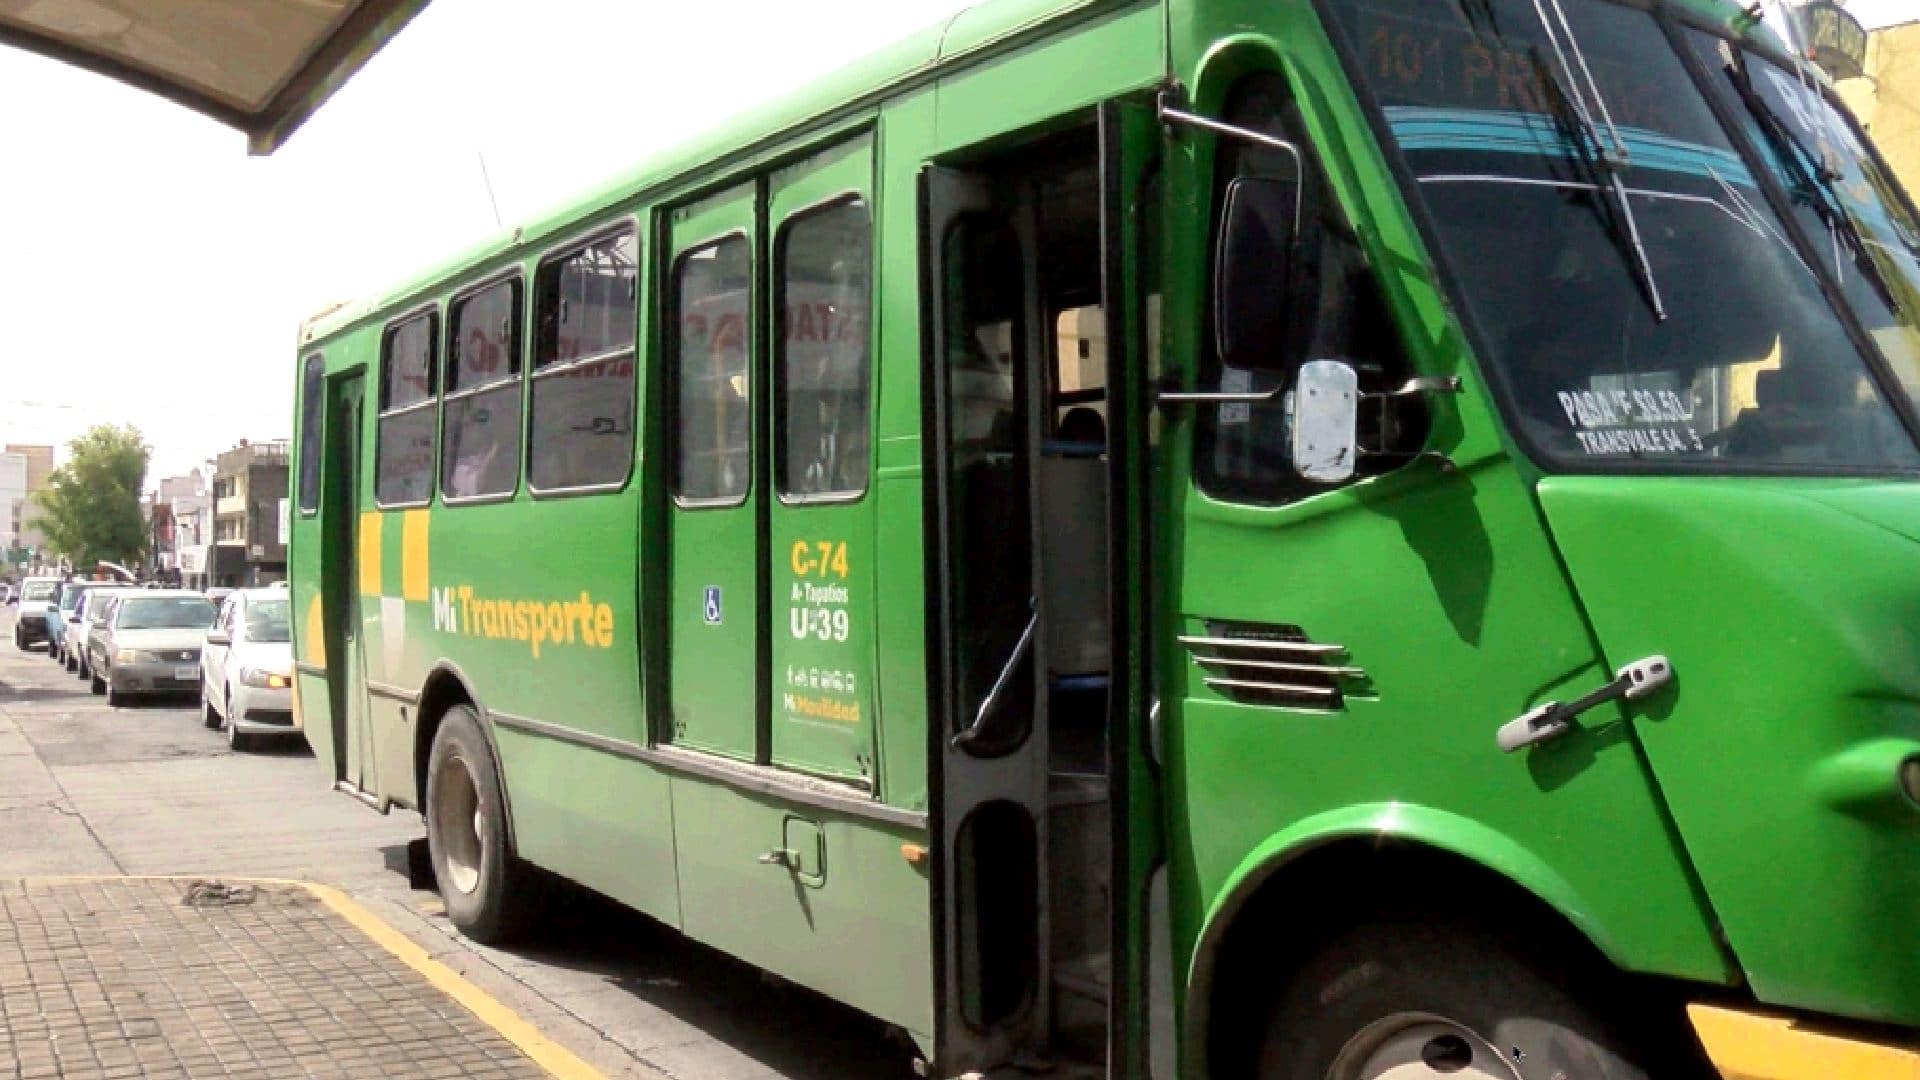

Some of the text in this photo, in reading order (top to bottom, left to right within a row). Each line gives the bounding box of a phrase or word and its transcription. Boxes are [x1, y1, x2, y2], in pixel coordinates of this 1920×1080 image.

[1557, 390, 1632, 427] PASAE
[791, 539, 848, 578] C-74
[432, 584, 613, 660] Mi Transporte
[793, 694, 860, 722] Movilidad
